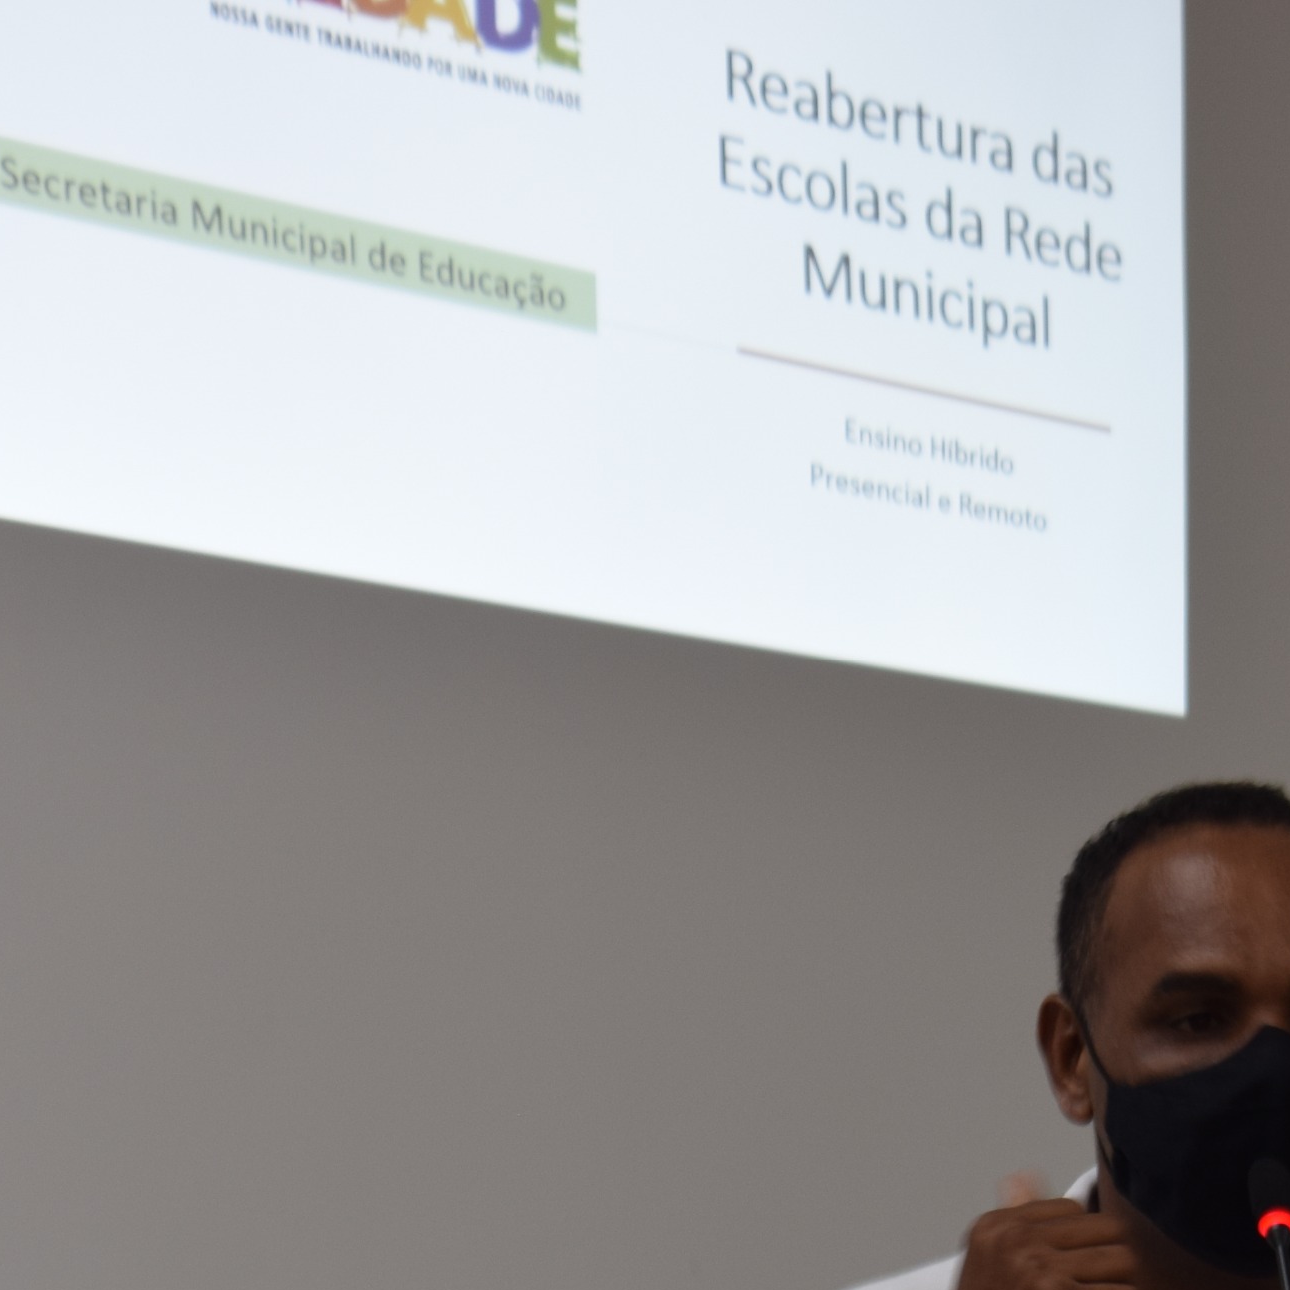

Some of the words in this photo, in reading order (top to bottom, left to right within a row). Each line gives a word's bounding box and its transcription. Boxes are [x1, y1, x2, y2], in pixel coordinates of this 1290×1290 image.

[210, 1, 259, 29] NOSSA
[264, 15, 310, 41] GENTE
[316, 26, 422, 69] TRABALHANDO
[427, 55, 453, 77] POR
[457, 63, 488, 86] UMA
[493, 71, 530, 98] NOVA
[534, 81, 583, 112] CIDADE
[725, 46, 1012, 174] Reabertura
[1031, 128, 1114, 199] das
[0, 156, 178, 227] Secretaria
[191, 199, 356, 265] Municipal
[367, 241, 406, 278] de
[418, 251, 567, 312] Educação
[719, 133, 908, 231] Escolas
[925, 185, 984, 250] da
[1004, 205, 1124, 284] Rede
[803, 243, 1050, 350] Municipal
[810, 462, 931, 510] Presencial
[938, 493, 952, 514] e
[958, 492, 1048, 534] Remoto
[844, 416, 923, 458] Ensino
[929, 436, 1015, 477] Híbrido
